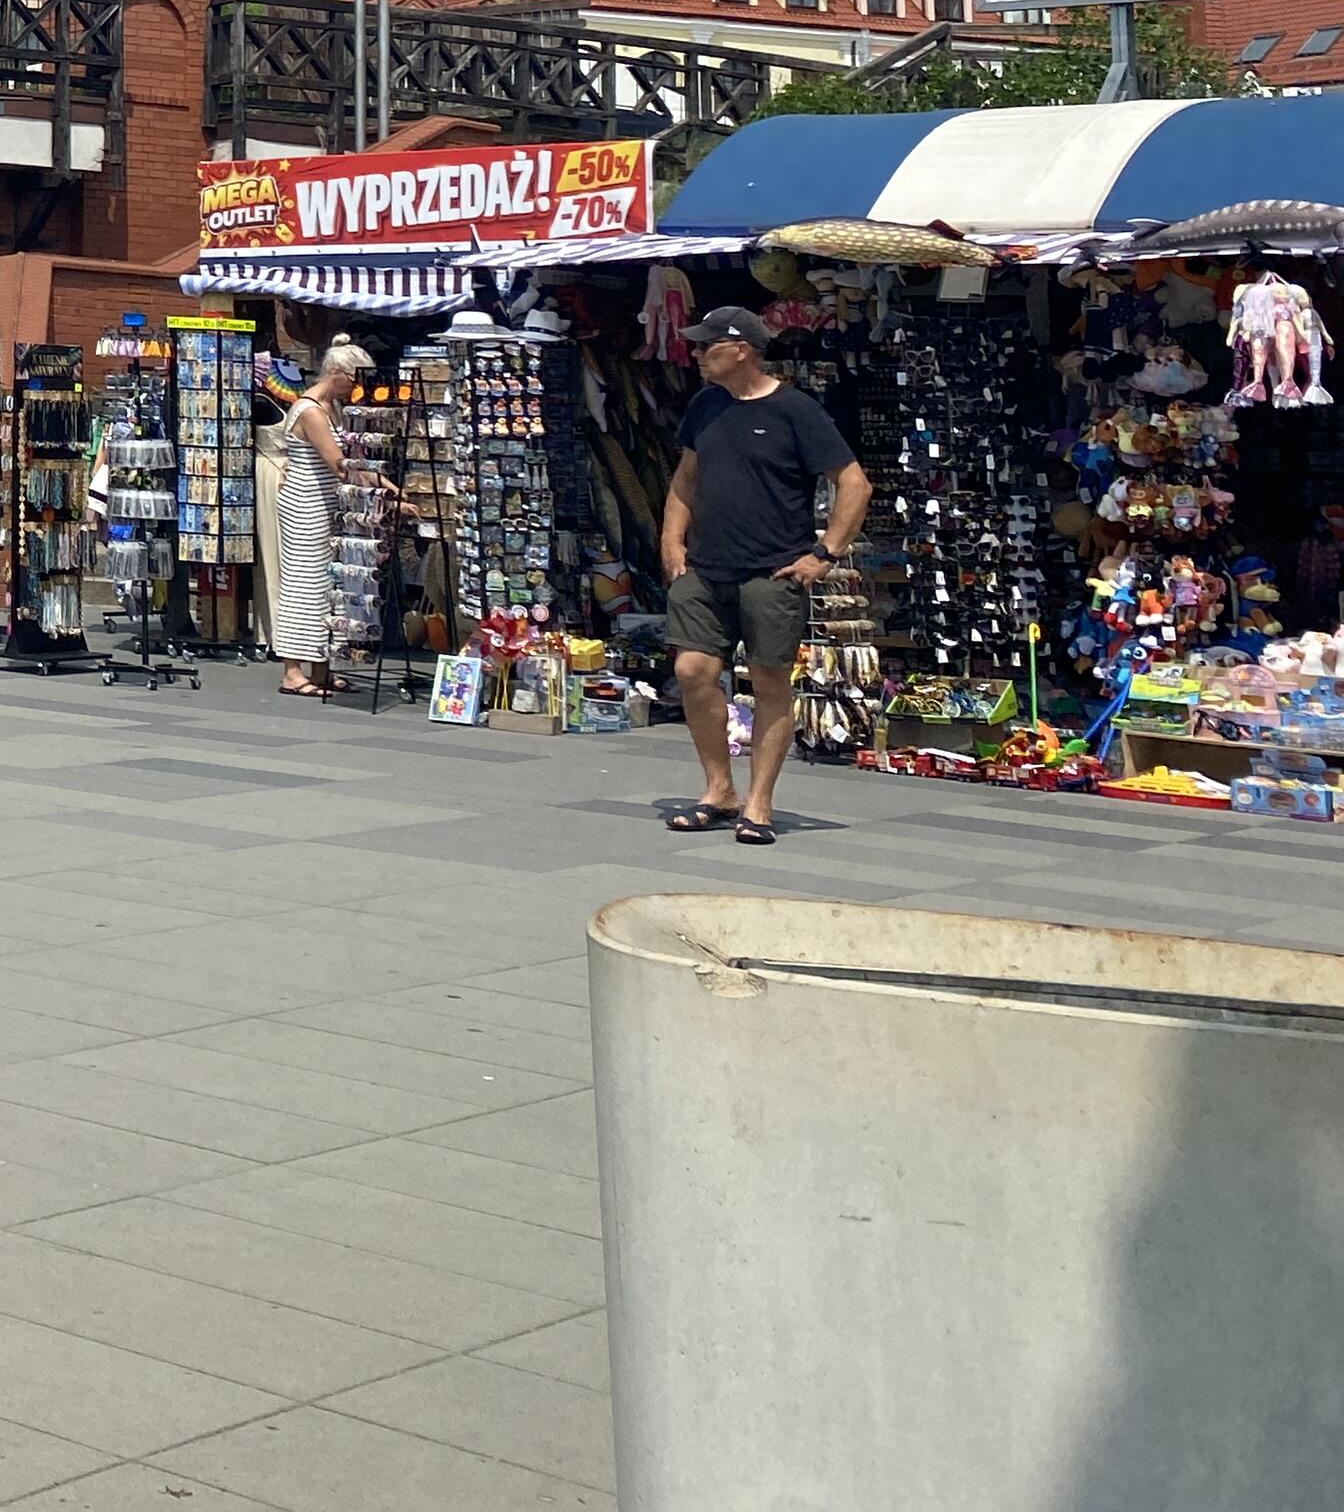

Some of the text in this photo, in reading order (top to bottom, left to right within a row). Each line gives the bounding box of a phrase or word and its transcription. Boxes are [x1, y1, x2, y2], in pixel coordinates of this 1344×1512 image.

[567, 149, 632, 185] -50%
[202, 179, 278, 212] MEGA
[295, 151, 552, 238] WYPRZEDAŻ!
[208, 205, 277, 231] OUTLET
[560, 196, 623, 231] -70%
